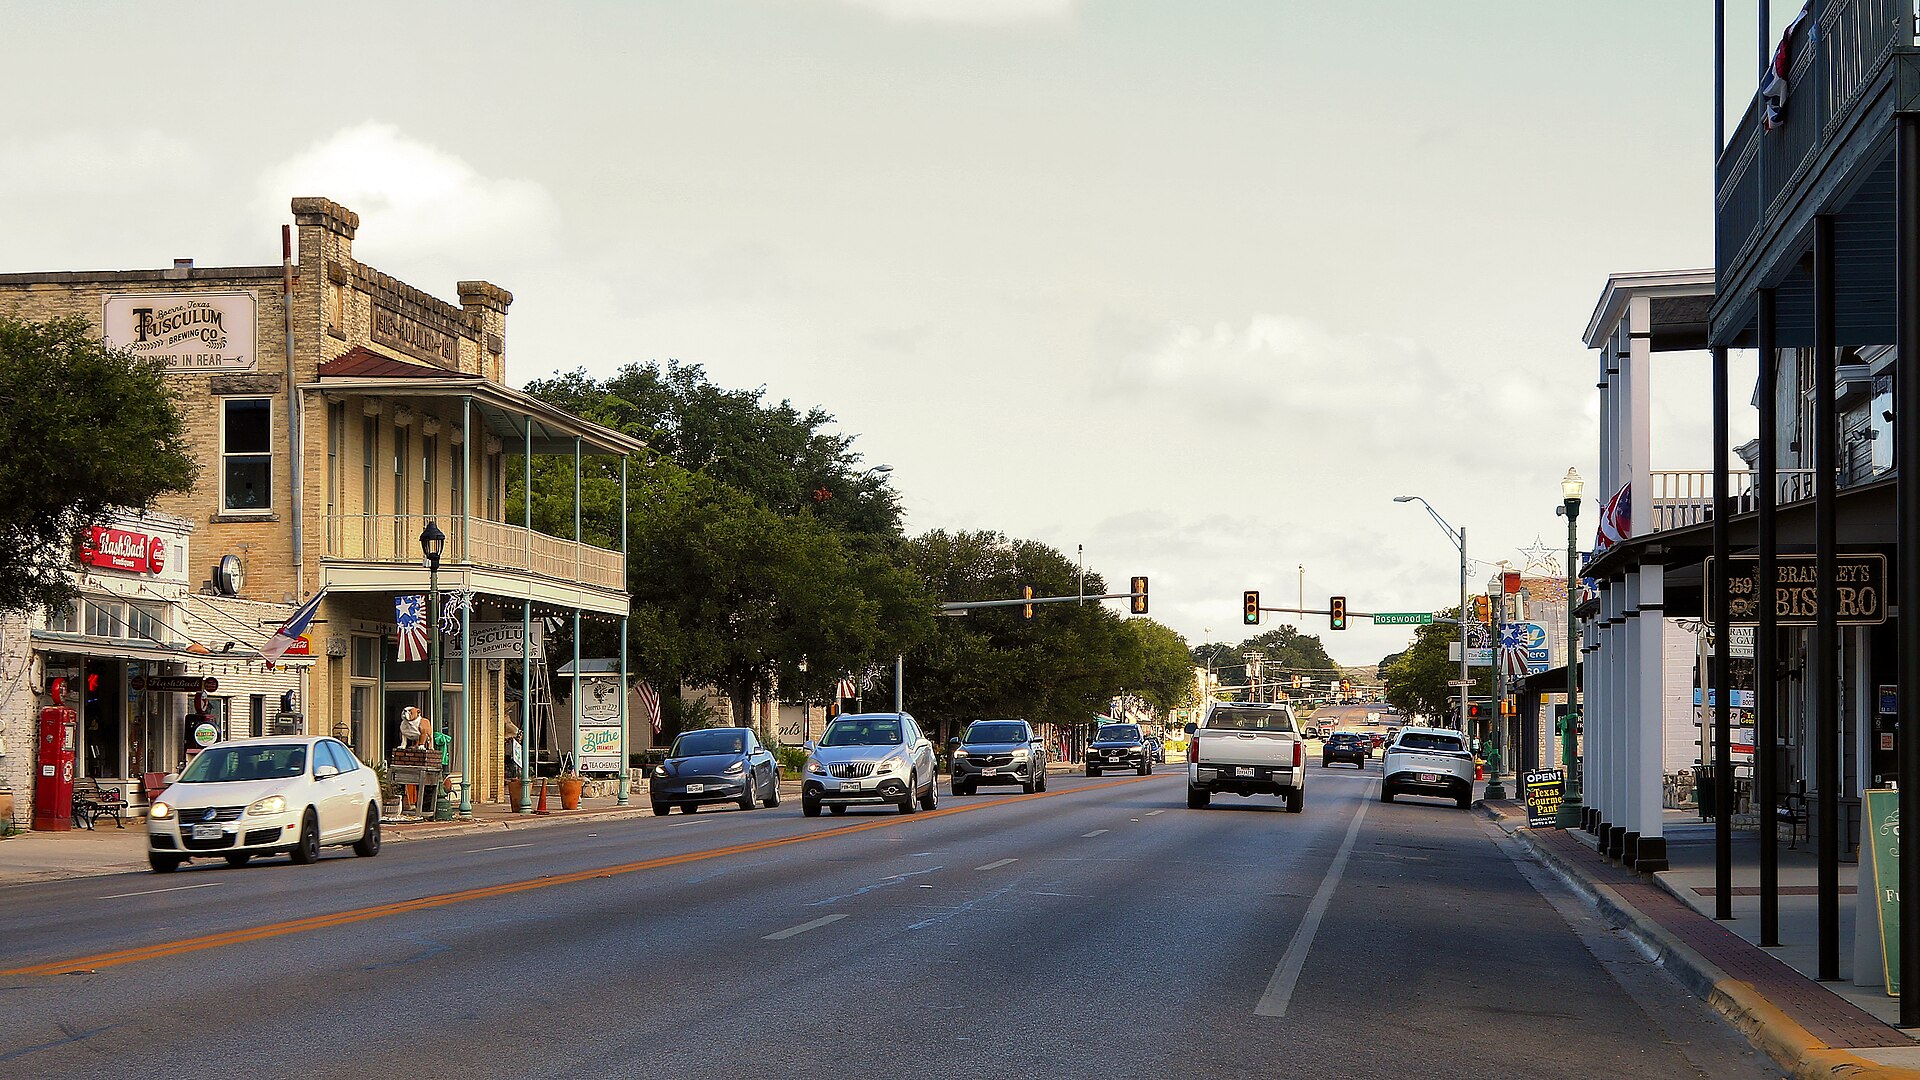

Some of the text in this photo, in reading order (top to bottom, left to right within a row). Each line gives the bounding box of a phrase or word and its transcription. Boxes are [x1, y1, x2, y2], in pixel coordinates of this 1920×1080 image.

[187, 300, 211, 309] Texas
[133, 308, 228, 342] TUSCULUM
[168, 328, 200, 345] BREWING
[182, 354, 192, 366] IN
[197, 353, 222, 366] REAR
[1777, 565, 1870, 583] BRANEY'S
[1776, 587, 1877, 616] BISRO
[1375, 614, 1421, 623] Rosewood
[482, 642, 512, 653] BREWING
[607, 703, 618, 712] 222
[582, 730, 619, 753] Blithe
[599, 761, 620, 769] CHEMIST
[1527, 771, 1562, 782] OPEN!
[1534, 788, 1559, 797] Texas
[1528, 796, 1564, 806] Gourme
[1537, 804, 1558, 813] Pant
